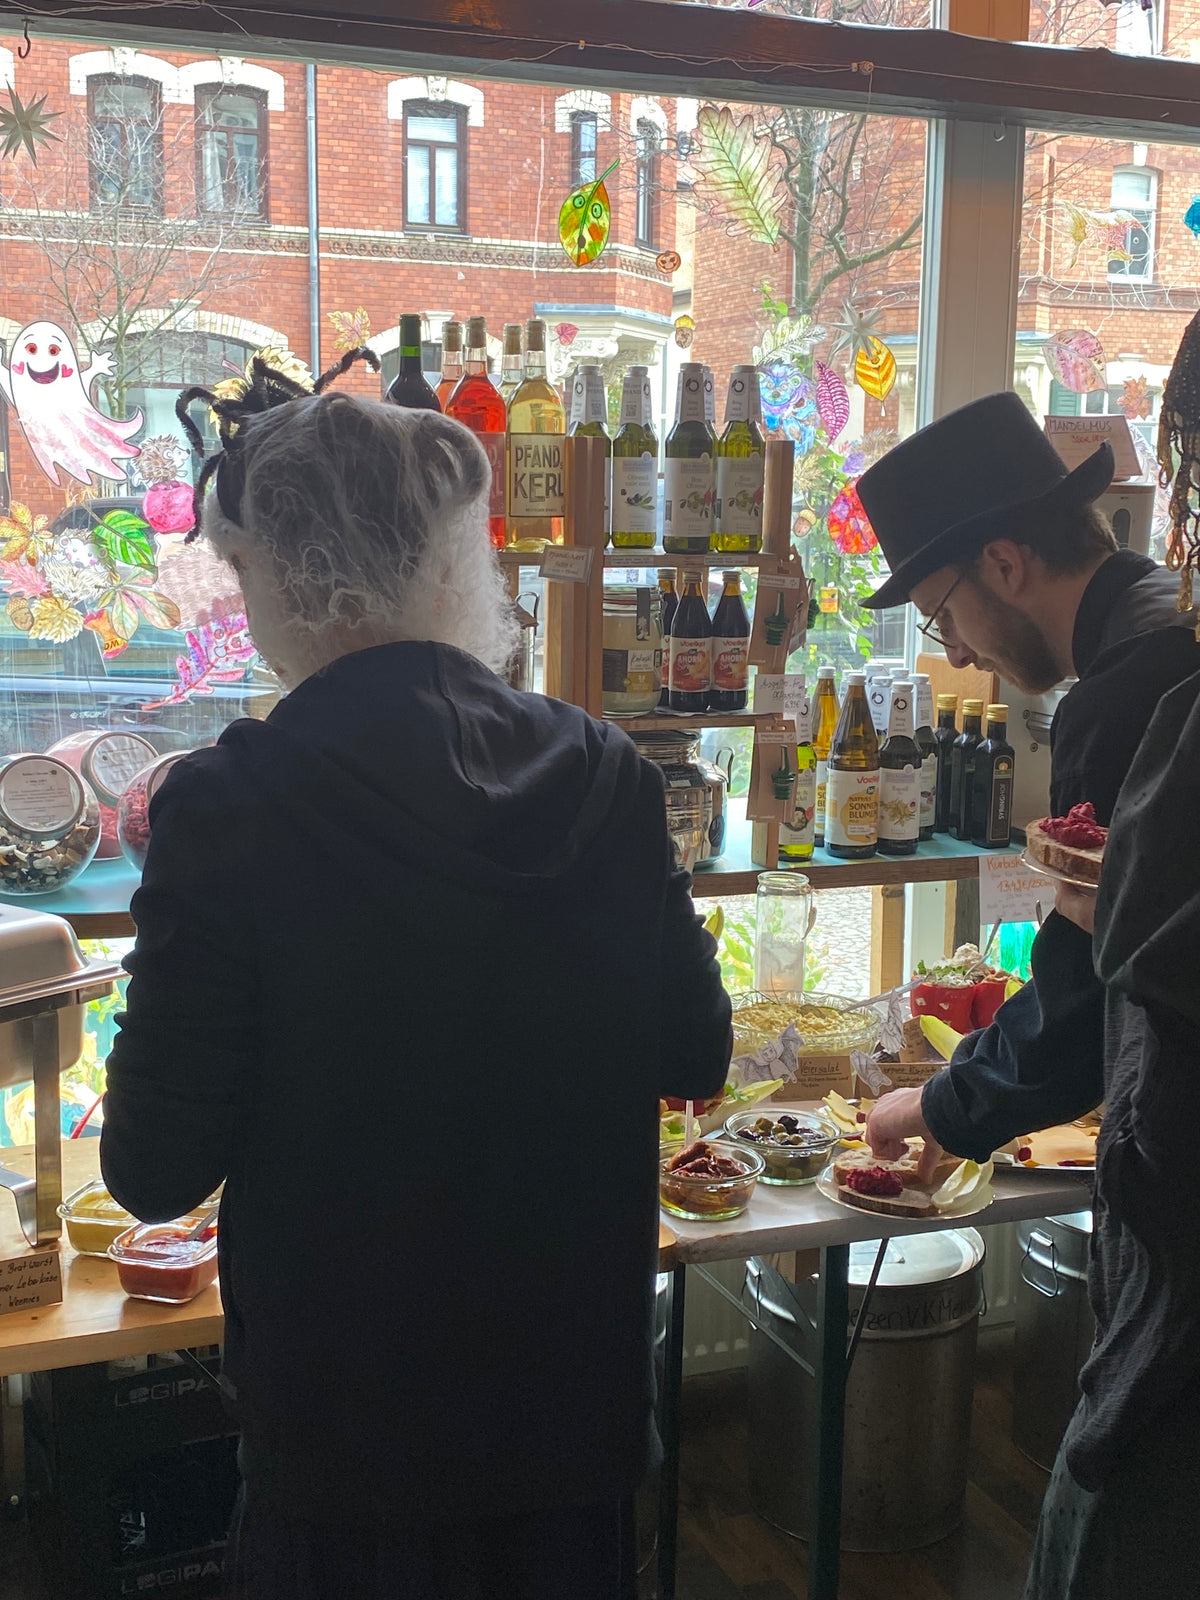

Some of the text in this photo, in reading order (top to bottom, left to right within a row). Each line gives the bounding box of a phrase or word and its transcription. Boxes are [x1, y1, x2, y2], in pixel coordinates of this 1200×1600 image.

[1049, 419, 1112, 432] MANDELMUS
[514, 472, 564, 502] KERL
[677, 655, 702, 663] AHORN
[720, 654, 744, 663] AHORN
[120, 1560, 225, 1595] LOGIPA
